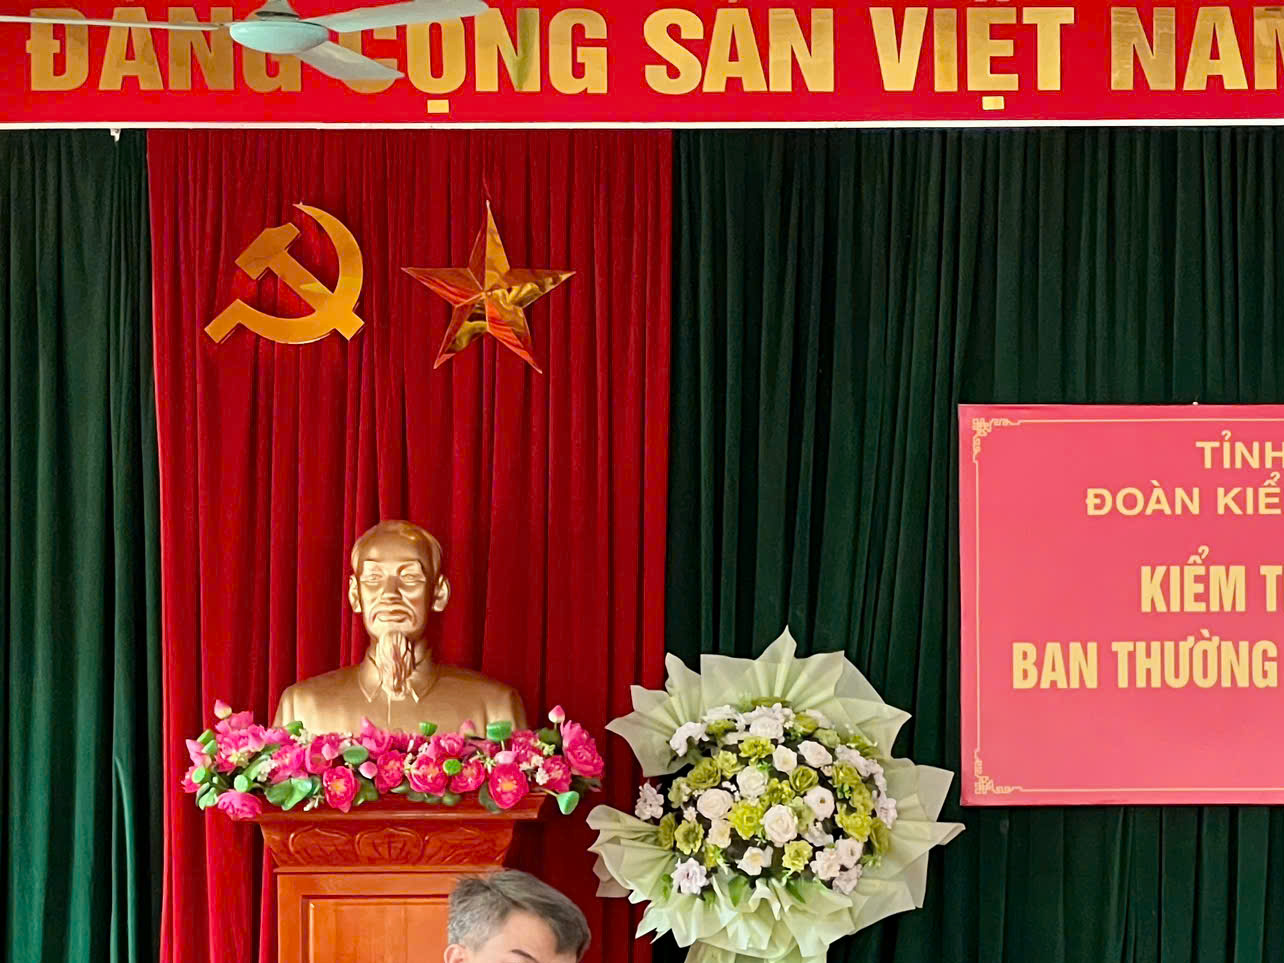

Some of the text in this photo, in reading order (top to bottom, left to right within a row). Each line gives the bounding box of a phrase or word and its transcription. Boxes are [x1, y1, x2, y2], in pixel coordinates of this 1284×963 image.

[1086, 480, 1200, 516] ĐOÀN
[1140, 545, 1246, 613] KIỂM
[1012, 641, 1098, 689] BAN
[1111, 629, 1278, 689] THƯỜNG
